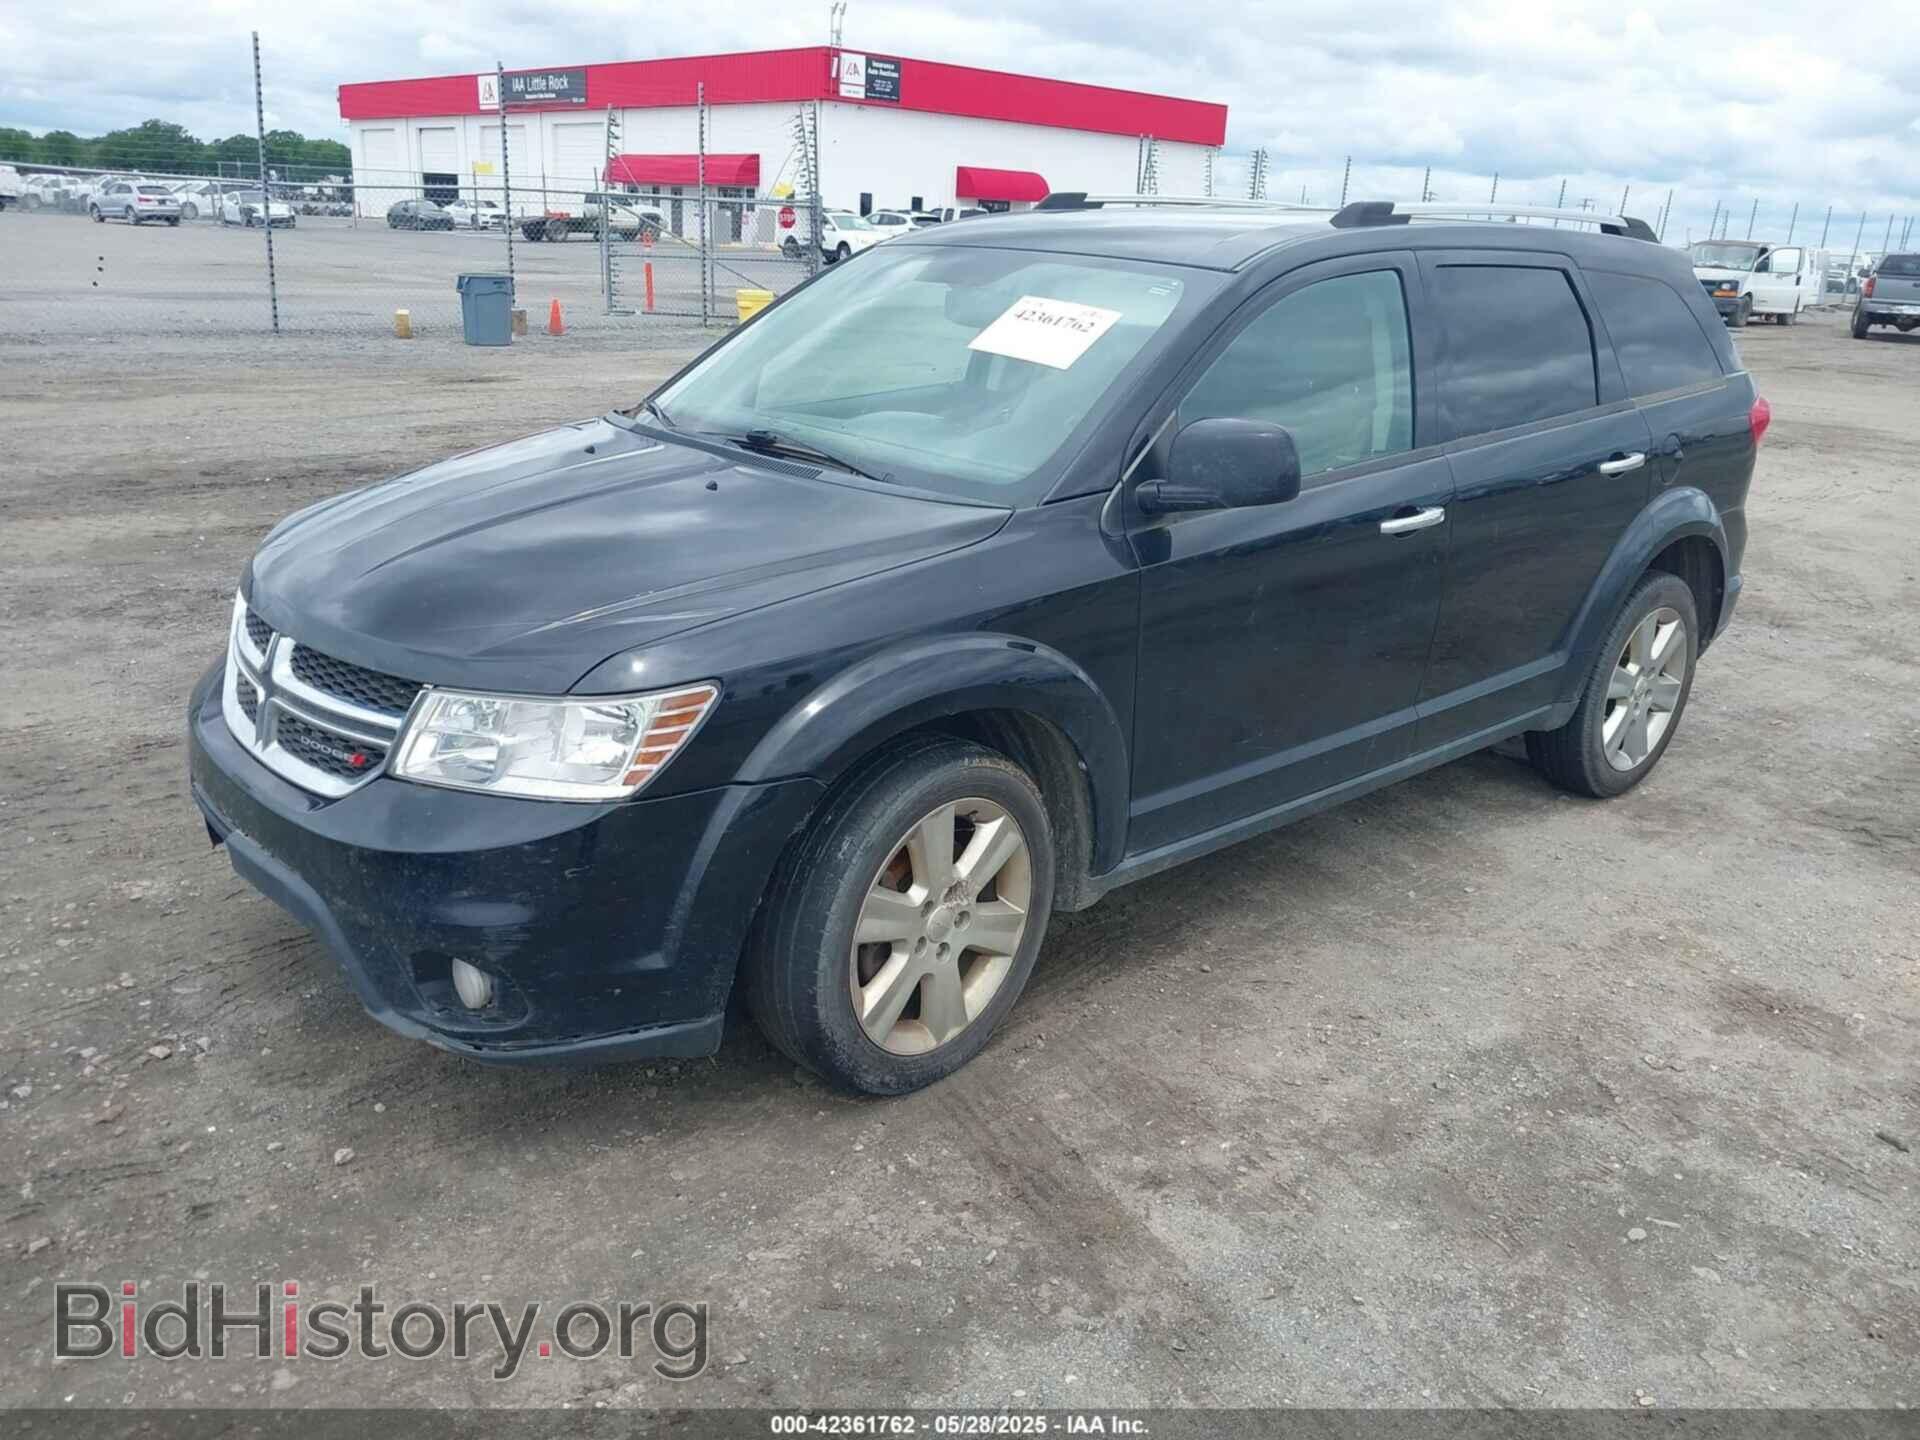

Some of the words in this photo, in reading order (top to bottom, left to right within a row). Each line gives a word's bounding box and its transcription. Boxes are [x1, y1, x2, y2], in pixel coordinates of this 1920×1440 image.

[512, 77, 525, 92] IAA
[527, 75, 547, 91] Little
[548, 74, 568, 90] Rock
